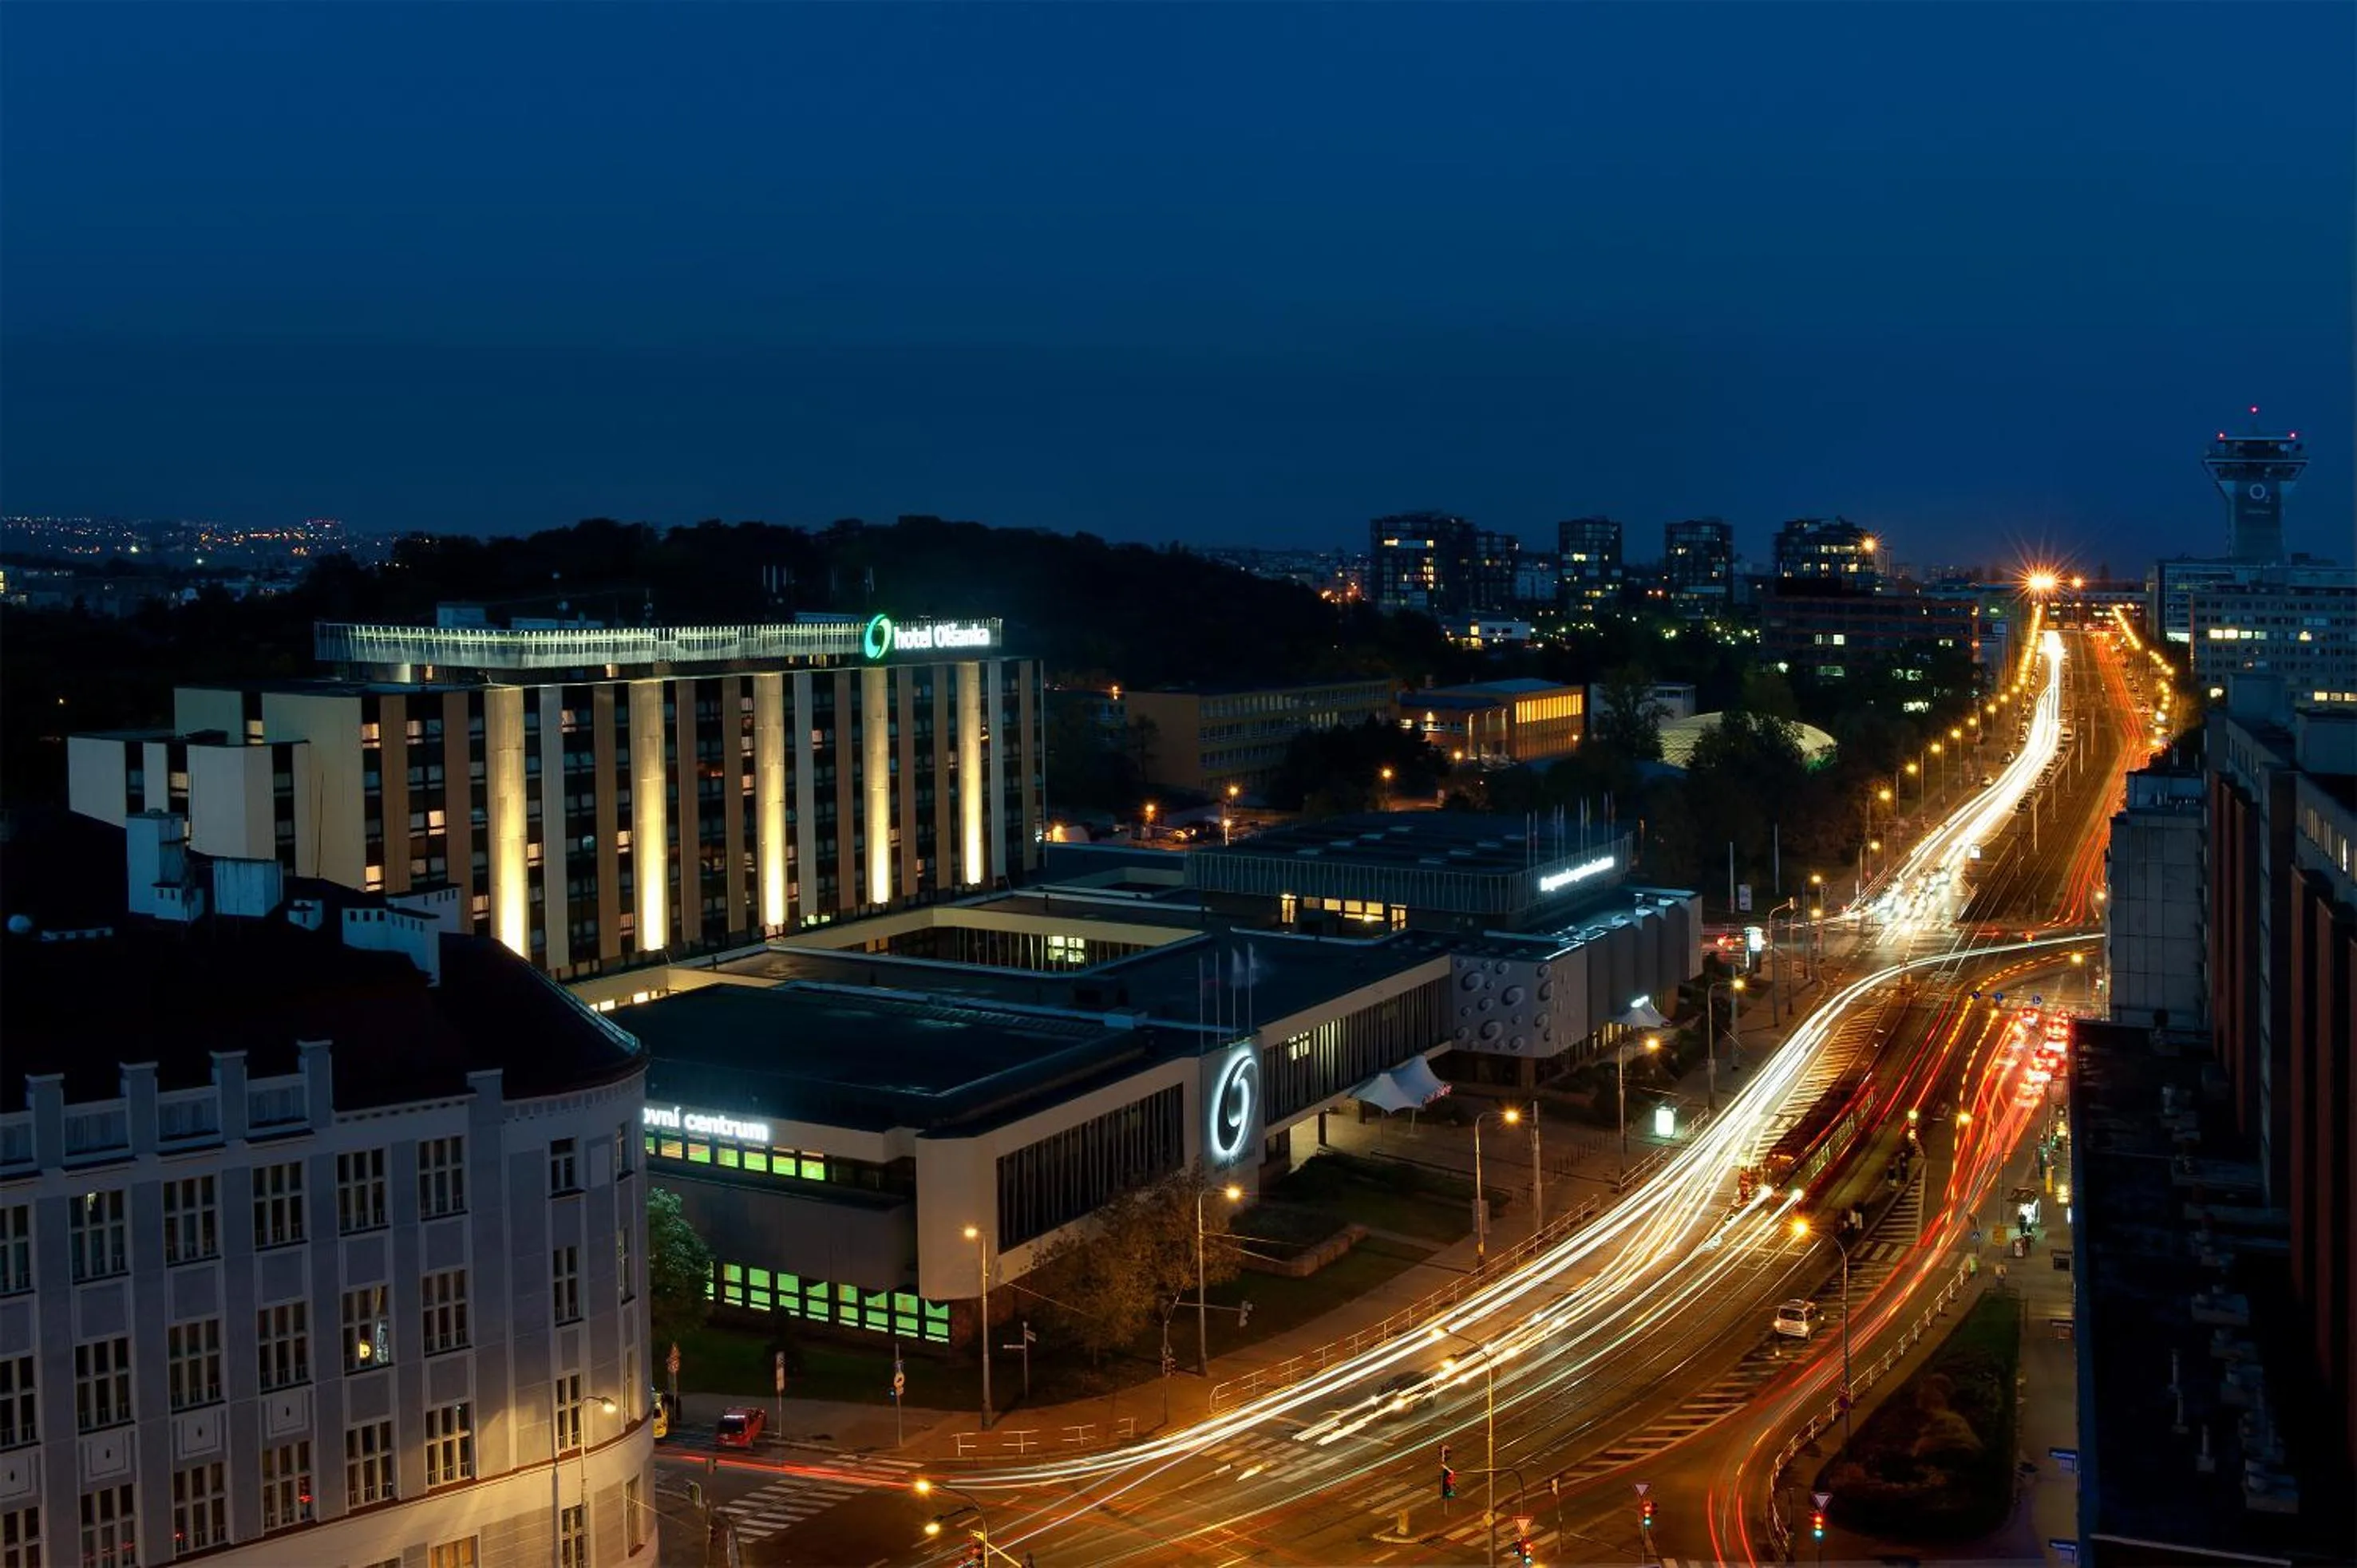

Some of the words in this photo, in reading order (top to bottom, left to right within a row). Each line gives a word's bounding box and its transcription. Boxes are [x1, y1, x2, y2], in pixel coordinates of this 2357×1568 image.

[893, 625, 932, 649] hotel
[934, 623, 990, 647] Olšanka
[684, 1114, 769, 1142] centrum
